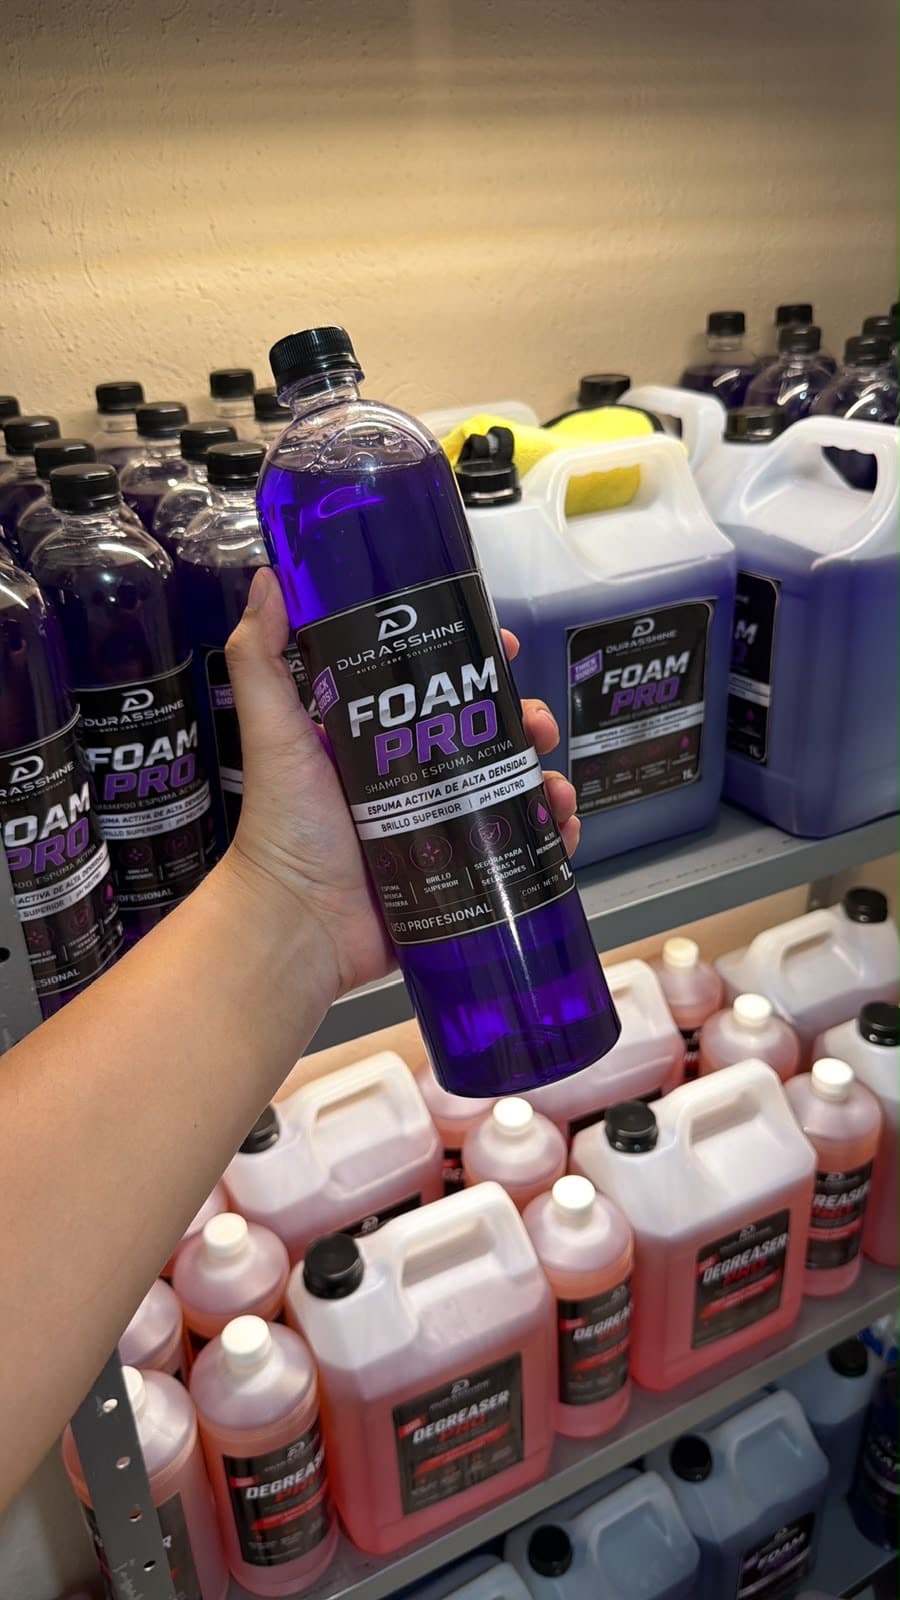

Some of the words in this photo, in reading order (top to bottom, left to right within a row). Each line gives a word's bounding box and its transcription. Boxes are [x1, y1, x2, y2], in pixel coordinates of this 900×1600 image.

[336, 620, 466, 671] DURASSHINE
[601, 650, 691, 695] FOAM
[84, 699, 184, 727] DURASSHINE
[347, 655, 499, 737] FOAM
[610, 675, 681, 717] PRO
[86, 720, 198, 773] FOAM
[373, 699, 498, 776] PRO
[0, 761, 75, 798] RASSHINE
[104, 753, 195, 801] PRO
[364, 772, 418, 794] SHAMPOO
[421, 754, 474, 778] ESPUMA
[477, 739, 514, 759] ACTIVA
[367, 800, 402, 816] ESPUMA
[404, 789, 442, 807] ACTIVA
[445, 782, 459, 794] DE
[462, 773, 486, 789] ALTA
[488, 756, 528, 779] DENSIDAD
[2, 781, 91, 848] OAM
[381, 818, 411, 833] BRILLO
[413, 803, 462, 824] SUPERIOR
[479, 793, 492, 805] pH
[493, 778, 525, 800] NEUTRO
[504, 847, 523, 860] PARA
[560, 861, 572, 881] 1L
[18, 891, 51, 905] ACTIVA
[53, 885, 65, 894] DE
[424, 879, 459, 893] SUPERIOR
[23, 900, 65, 918] SUPERIOR
[391, 921, 407, 932] USO
[407, 902, 493, 931] PROFESIONAL
[40, 968, 81, 987] SIONAL
[413, 1389, 511, 1444] DEGREASER
